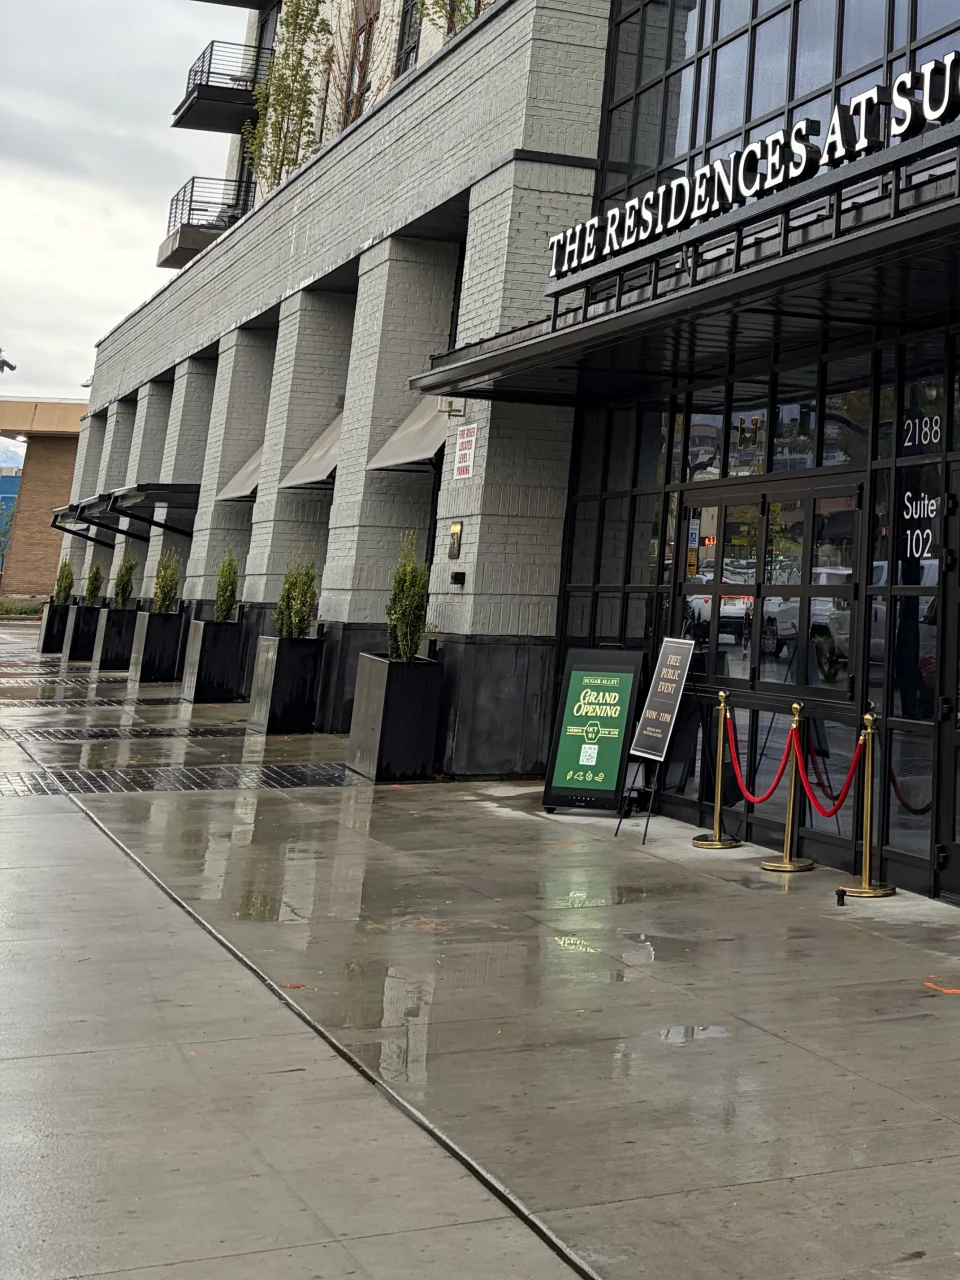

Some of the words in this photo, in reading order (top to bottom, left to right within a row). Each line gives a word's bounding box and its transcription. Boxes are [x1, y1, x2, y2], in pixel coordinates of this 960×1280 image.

[548, 216, 599, 277] THE
[602, 117, 807, 256] RESIDENCES
[819, 84, 880, 166] AT
[903, 415, 942, 447] 2188
[903, 491, 937, 519] Suite
[905, 528, 933, 558] 102
[667, 655, 681, 666] FREE
[661, 668, 680, 680] PUBLIC
[658, 682, 676, 694] EVENT
[580, 689, 619, 704] GRAND
[573, 703, 620, 717] OPENING
